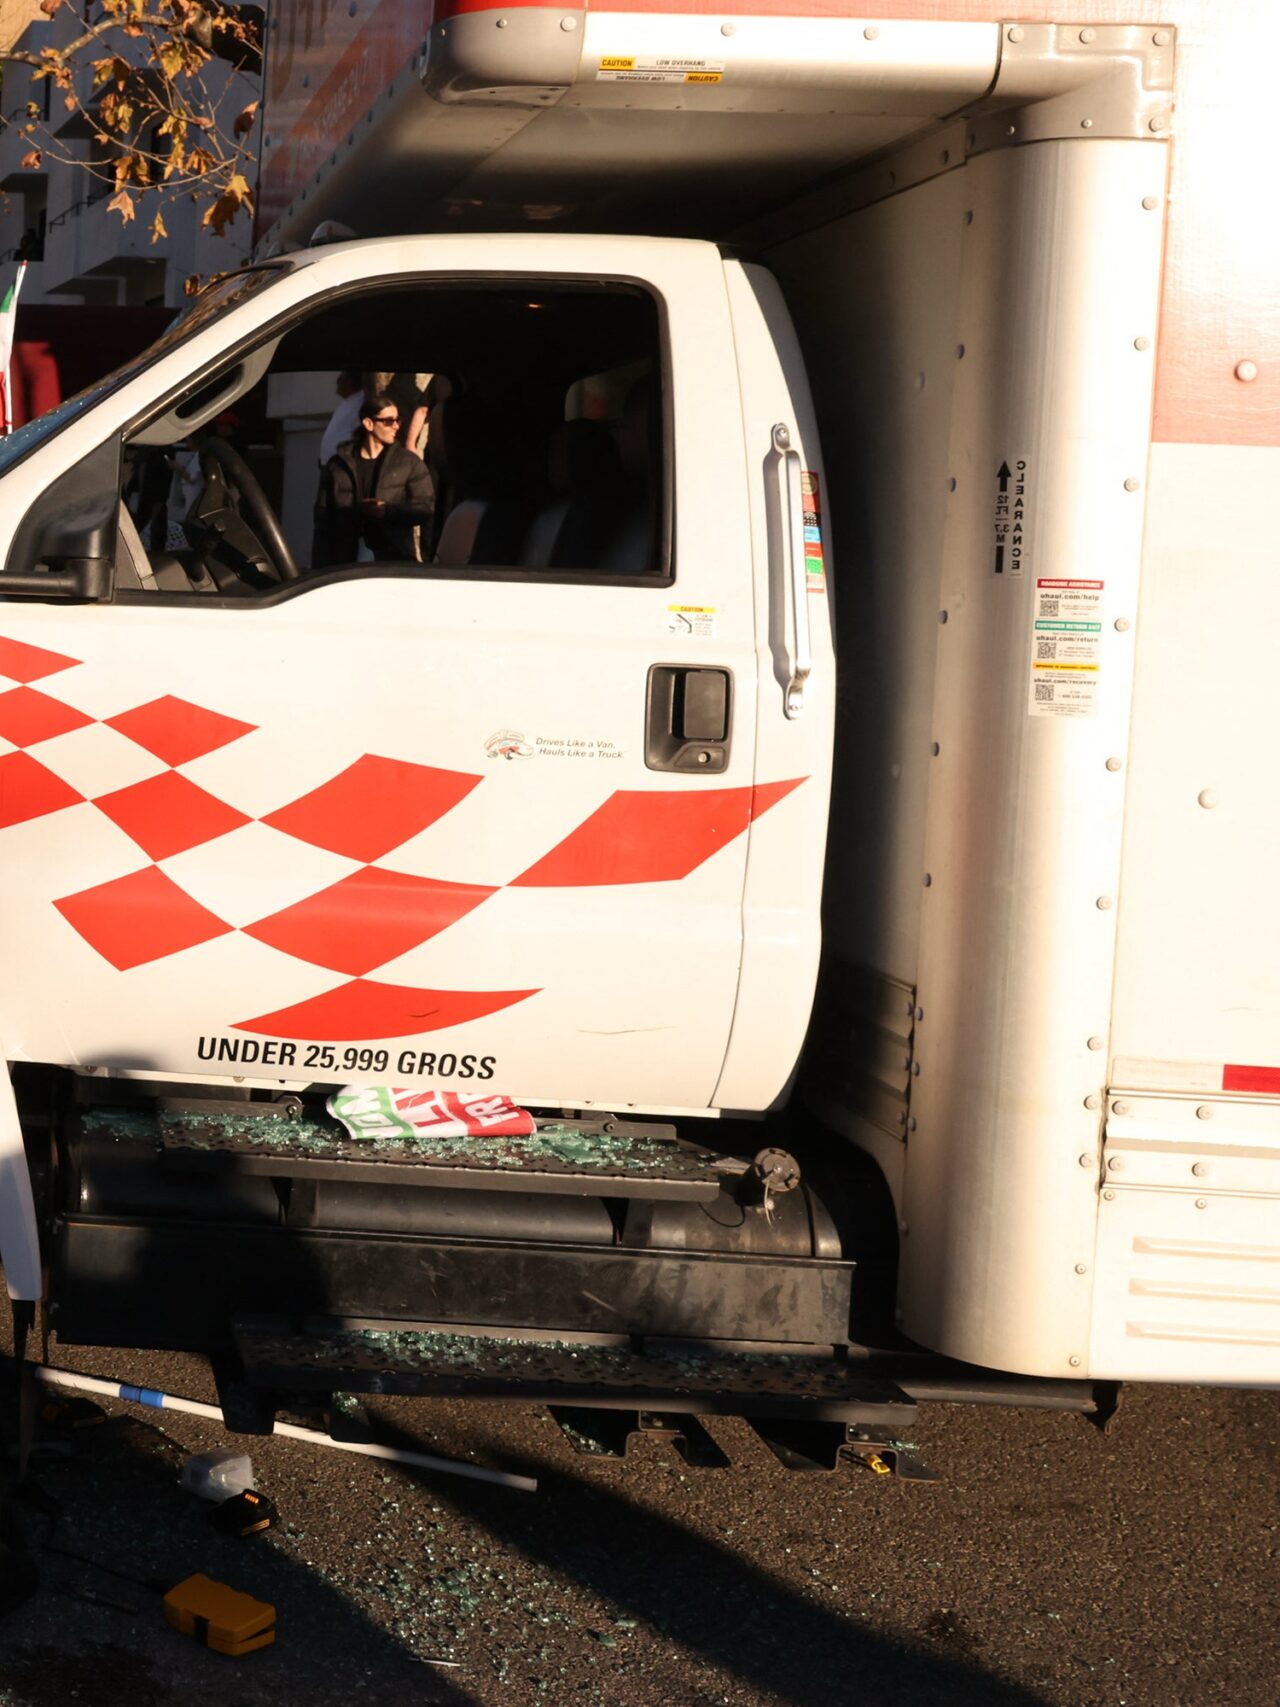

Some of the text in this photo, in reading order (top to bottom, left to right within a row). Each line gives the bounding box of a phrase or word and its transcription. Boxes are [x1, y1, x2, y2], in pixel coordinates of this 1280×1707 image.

[601, 59, 633, 67] CAUTION
[535, 737, 565, 747] Drives
[567, 739, 586, 748] Like
[539, 748, 565, 757] Hauls
[567, 749, 586, 758] Like
[197, 1036, 498, 1080] UNDER 25,999 GROSS
